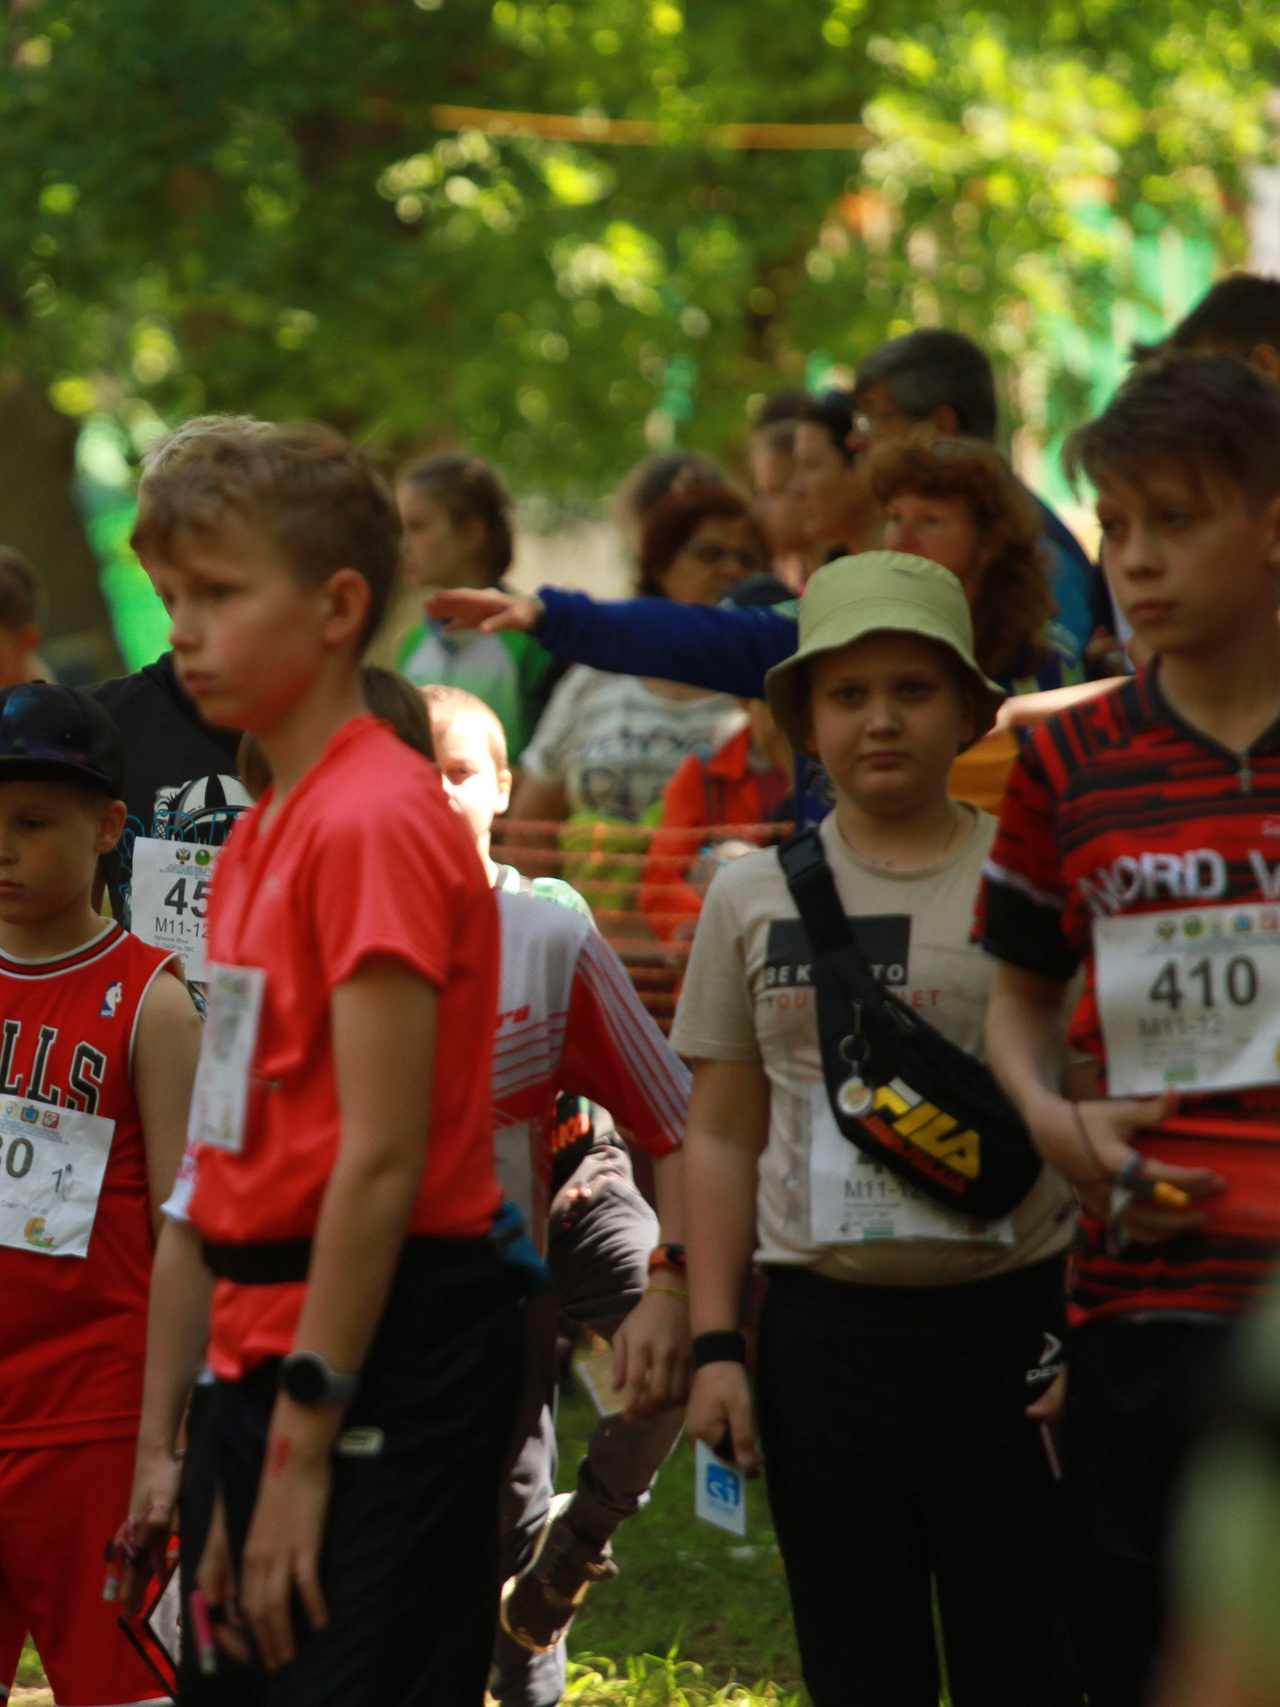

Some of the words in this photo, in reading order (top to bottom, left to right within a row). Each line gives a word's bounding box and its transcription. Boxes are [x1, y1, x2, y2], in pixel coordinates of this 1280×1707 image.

[164, 878, 210, 918] 45
[1078, 848, 1227, 919] NORD
[1149, 955, 1259, 1009] 410
[873, 1076, 980, 1179] FILA
